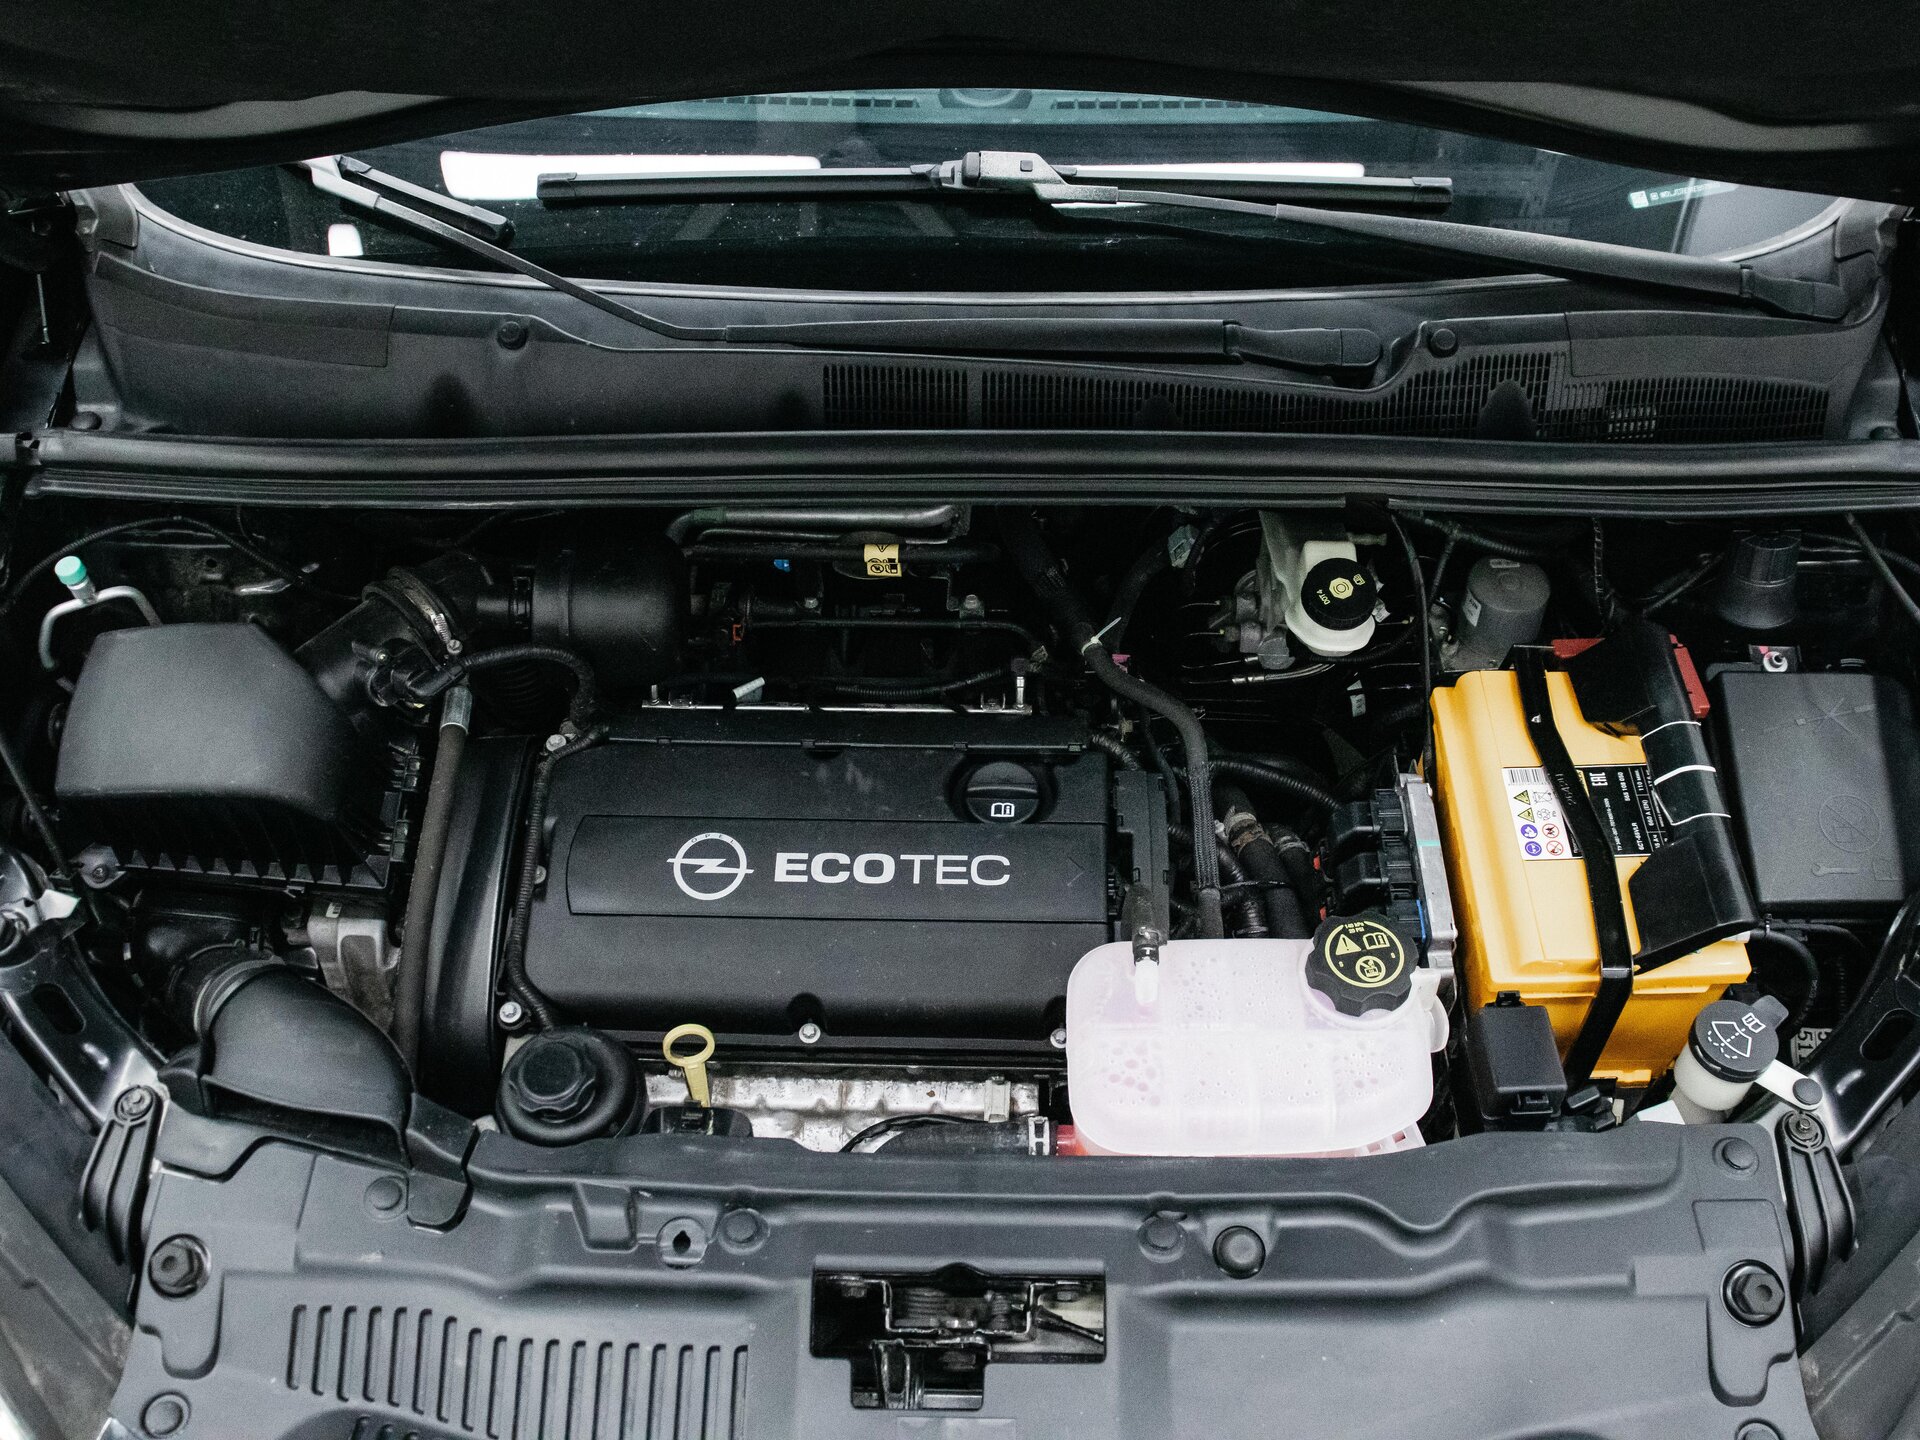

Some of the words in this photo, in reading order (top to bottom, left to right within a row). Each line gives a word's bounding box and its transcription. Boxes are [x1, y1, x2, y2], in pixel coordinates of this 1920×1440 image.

[1319, 594, 1330, 605] DOT
[691, 834, 734, 844] OPEL
[774, 853, 1010, 885] ECOTEC
